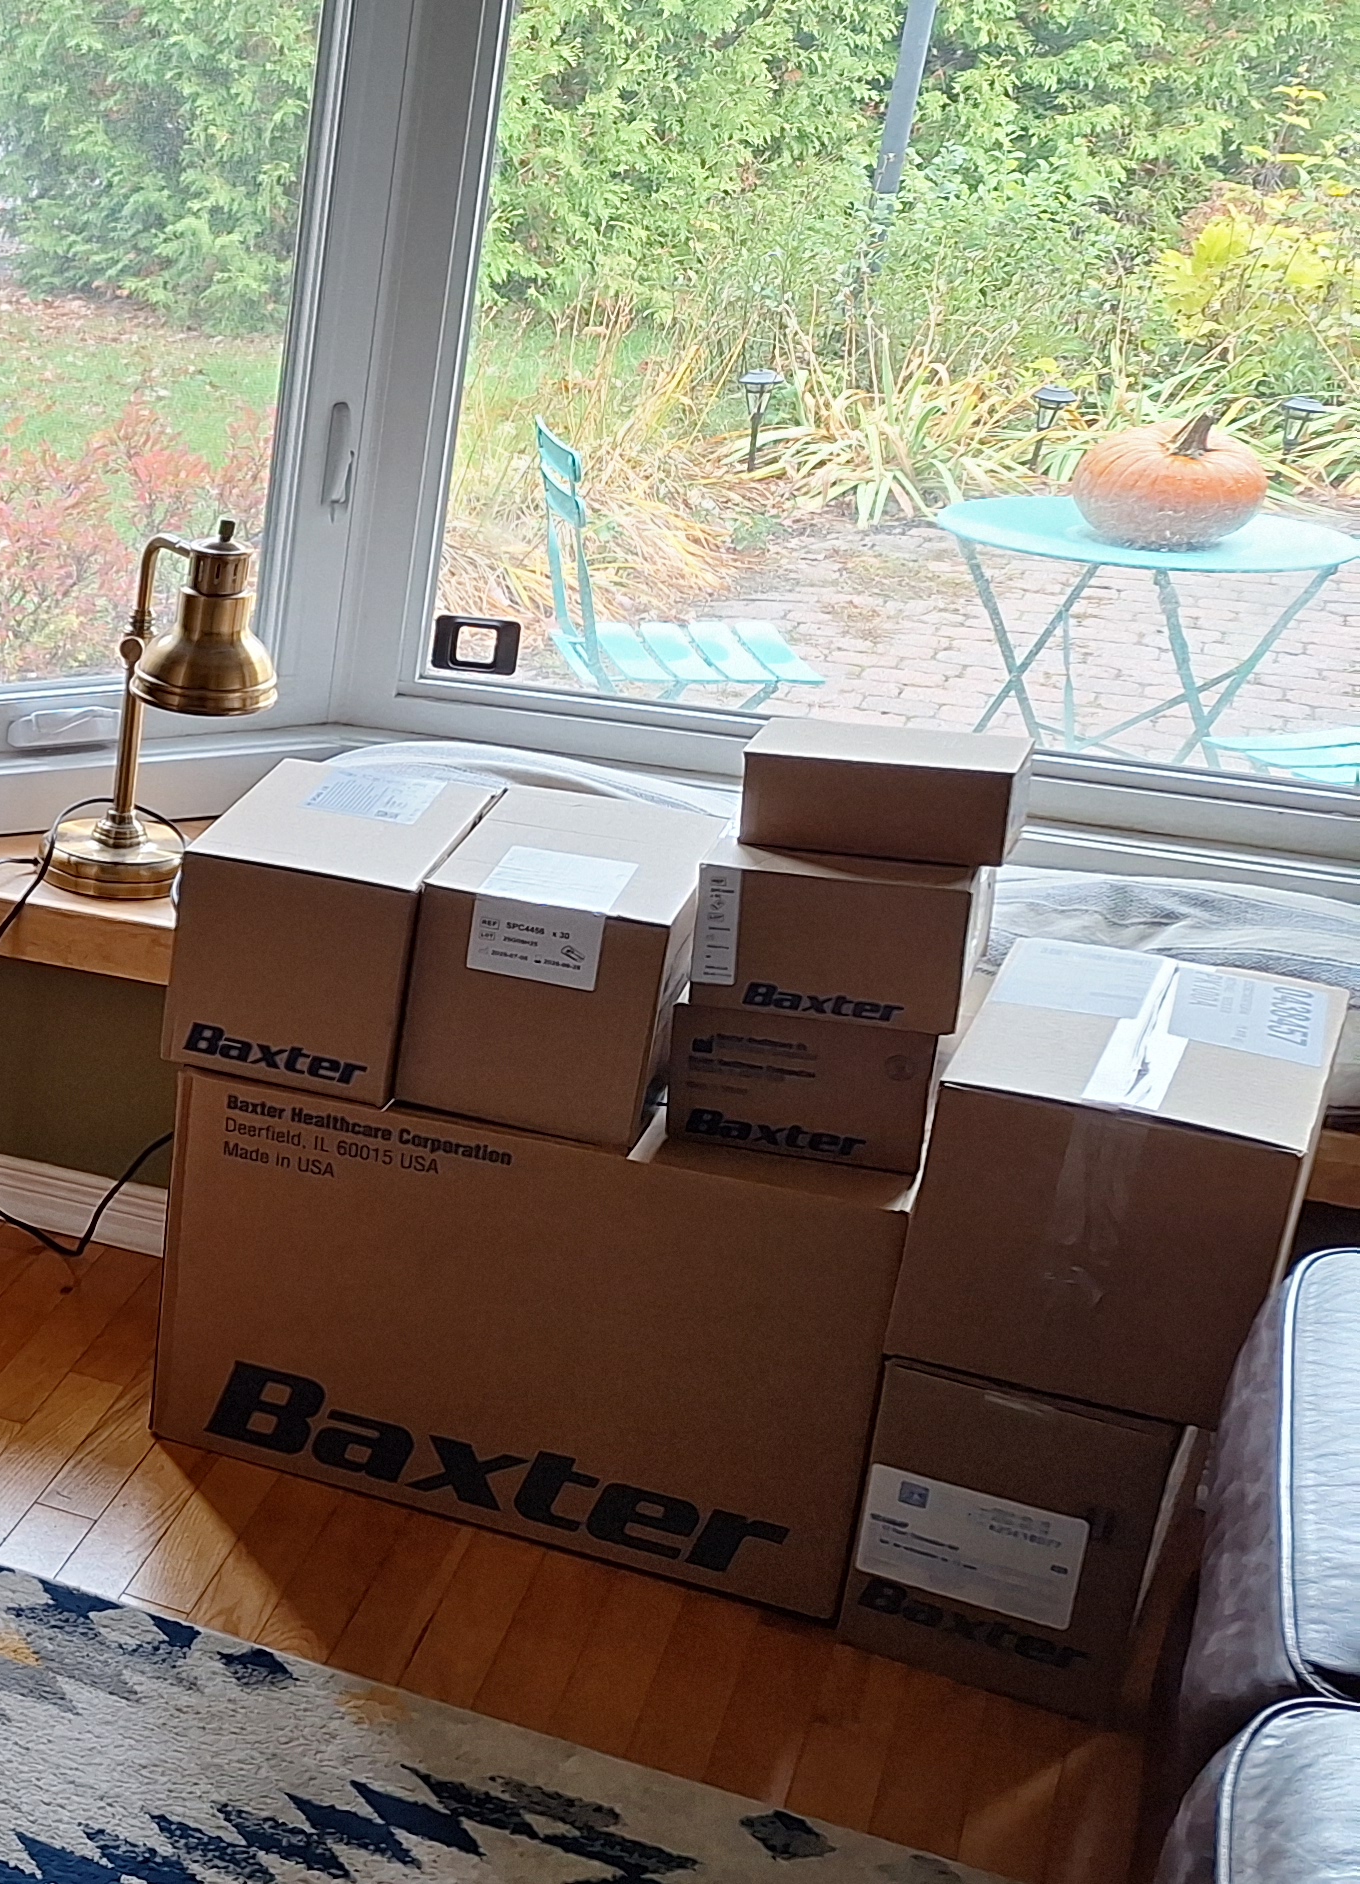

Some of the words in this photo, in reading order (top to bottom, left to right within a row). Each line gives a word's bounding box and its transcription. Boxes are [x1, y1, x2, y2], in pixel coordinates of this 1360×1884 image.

[742, 981, 904, 1022] Baxter
[1267, 986, 1315, 1046] 0438457
[182, 1021, 367, 1085] Baxter
[227, 1094, 286, 1121] Baxter
[291, 1107, 392, 1142] Healthcare
[399, 1128, 513, 1166] Corporation
[314, 1136, 330, 1153] IL
[337, 1142, 394, 1165] 60015
[400, 1154, 440, 1175] USA
[685, 1108, 867, 1157] Baxter
[223, 1140, 270, 1165] Made
[297, 1157, 335, 1178] USA
[203, 1360, 790, 1572] Baxter
